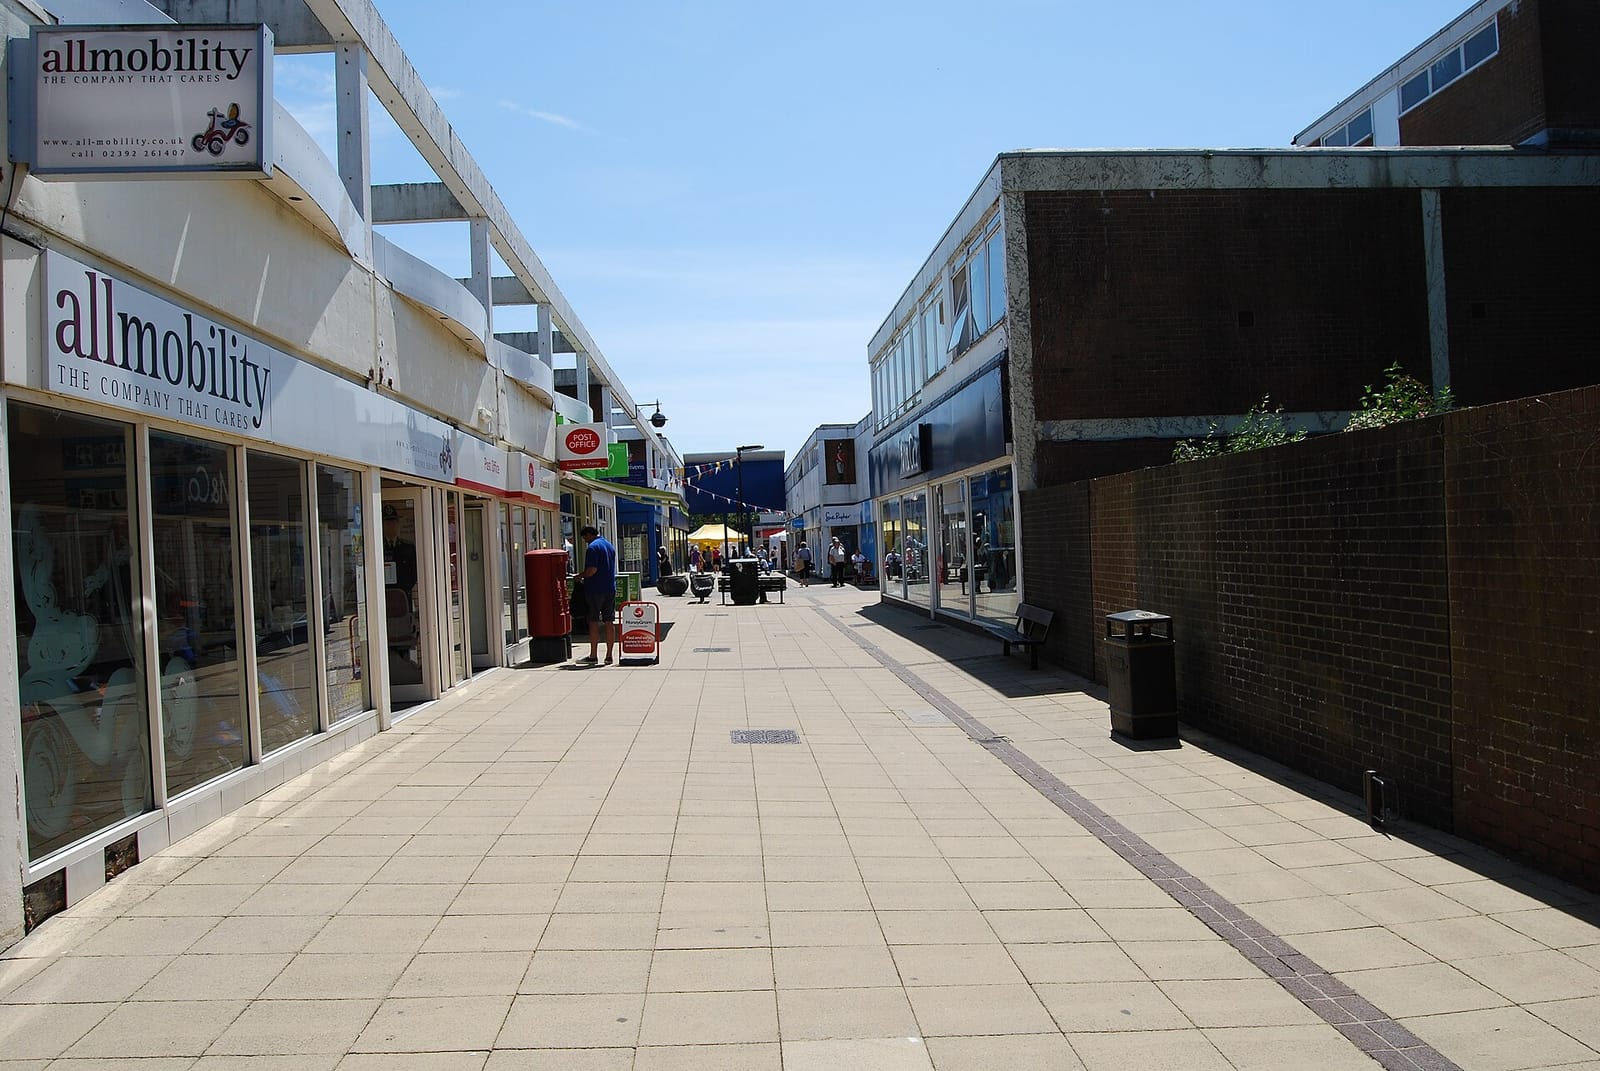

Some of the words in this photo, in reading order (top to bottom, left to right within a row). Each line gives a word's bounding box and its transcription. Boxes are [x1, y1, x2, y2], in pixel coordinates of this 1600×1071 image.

[42, 38, 253, 81] allmobility
[44, 75, 67, 84] THE
[74, 75, 135, 84] COMPANY
[142, 75, 174, 83] THAT
[181, 74, 221, 83] CARES
[43, 136, 185, 148] www.all-mobility.co.uk
[71, 150, 95, 158] call
[102, 150, 137, 158] 02392
[143, 149, 186, 157] 261407
[55, 271, 271, 429] allmobility
[58, 364, 90, 391] THE
[100, 376, 171, 411] COMPANY
[178, 397, 209, 421] THAT
[215, 407, 249, 430] CARES
[573, 433, 593, 441] POST
[568, 440, 597, 449] OFFICE
